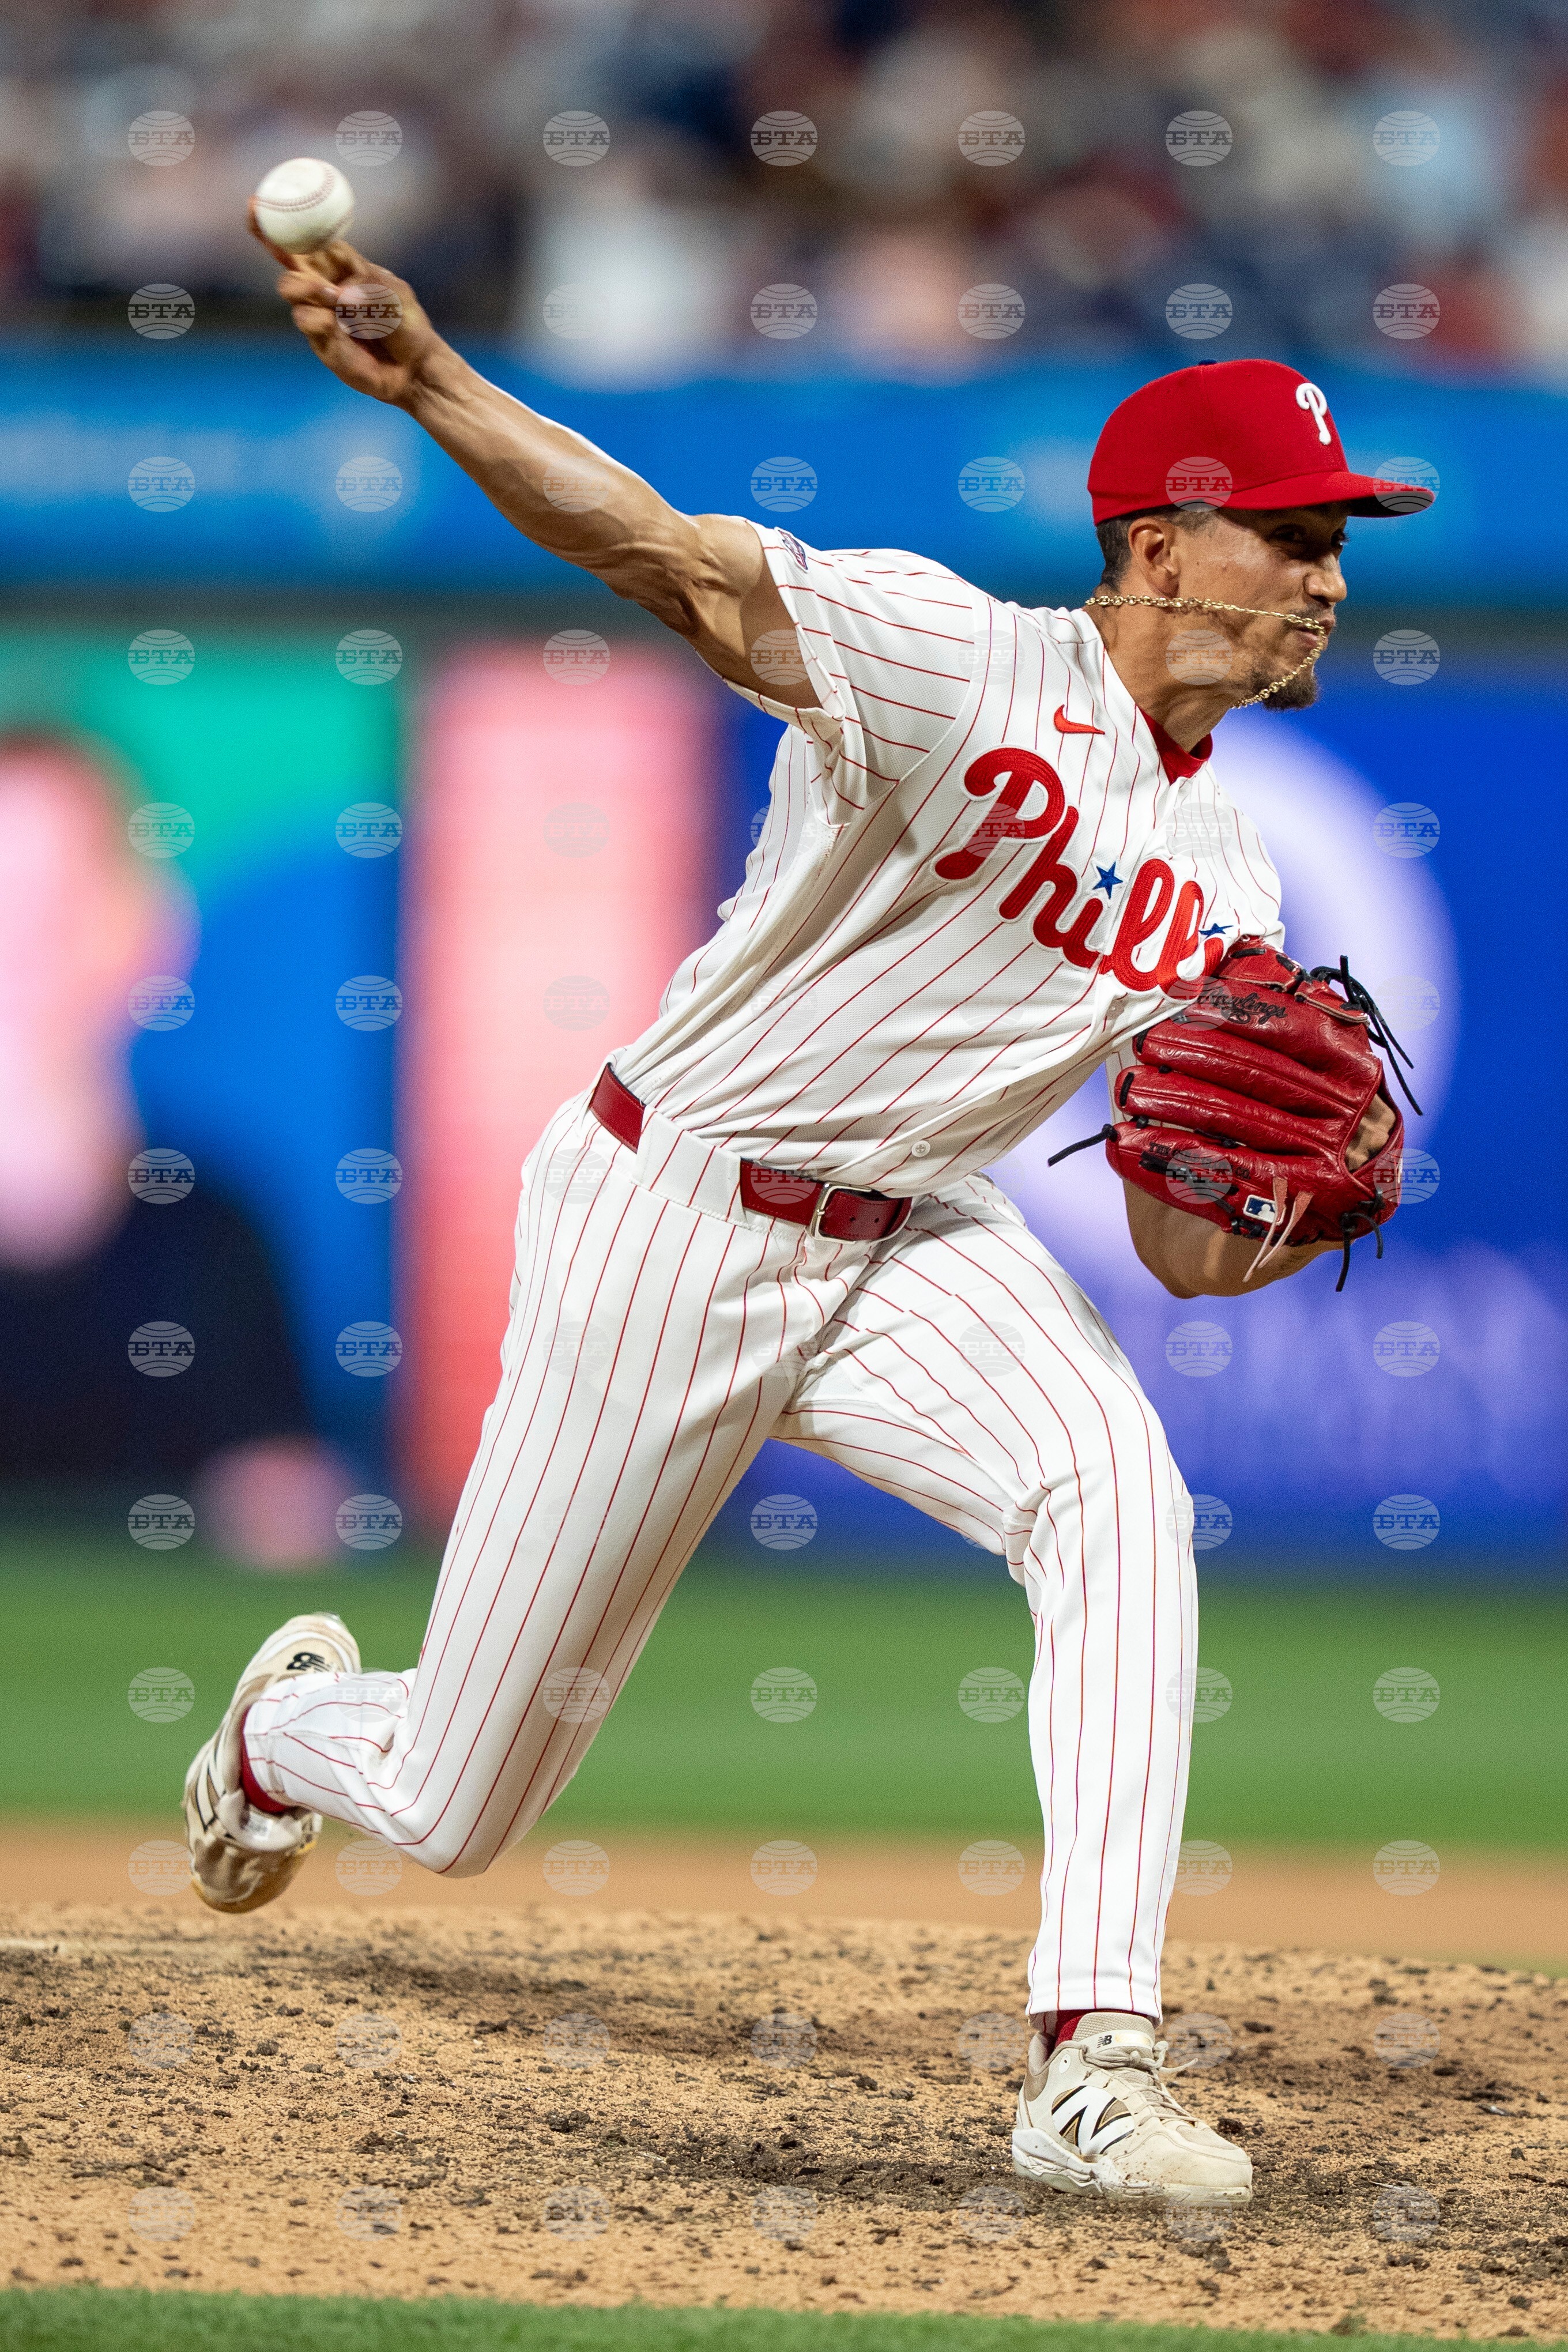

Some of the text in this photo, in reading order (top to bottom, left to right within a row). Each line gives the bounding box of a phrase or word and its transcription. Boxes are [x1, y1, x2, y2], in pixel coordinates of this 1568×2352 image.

[1295, 382, 1332, 445] P
[930, 744, 1226, 1002] Philli
[1196, 986, 1287, 1024] Rawlings
